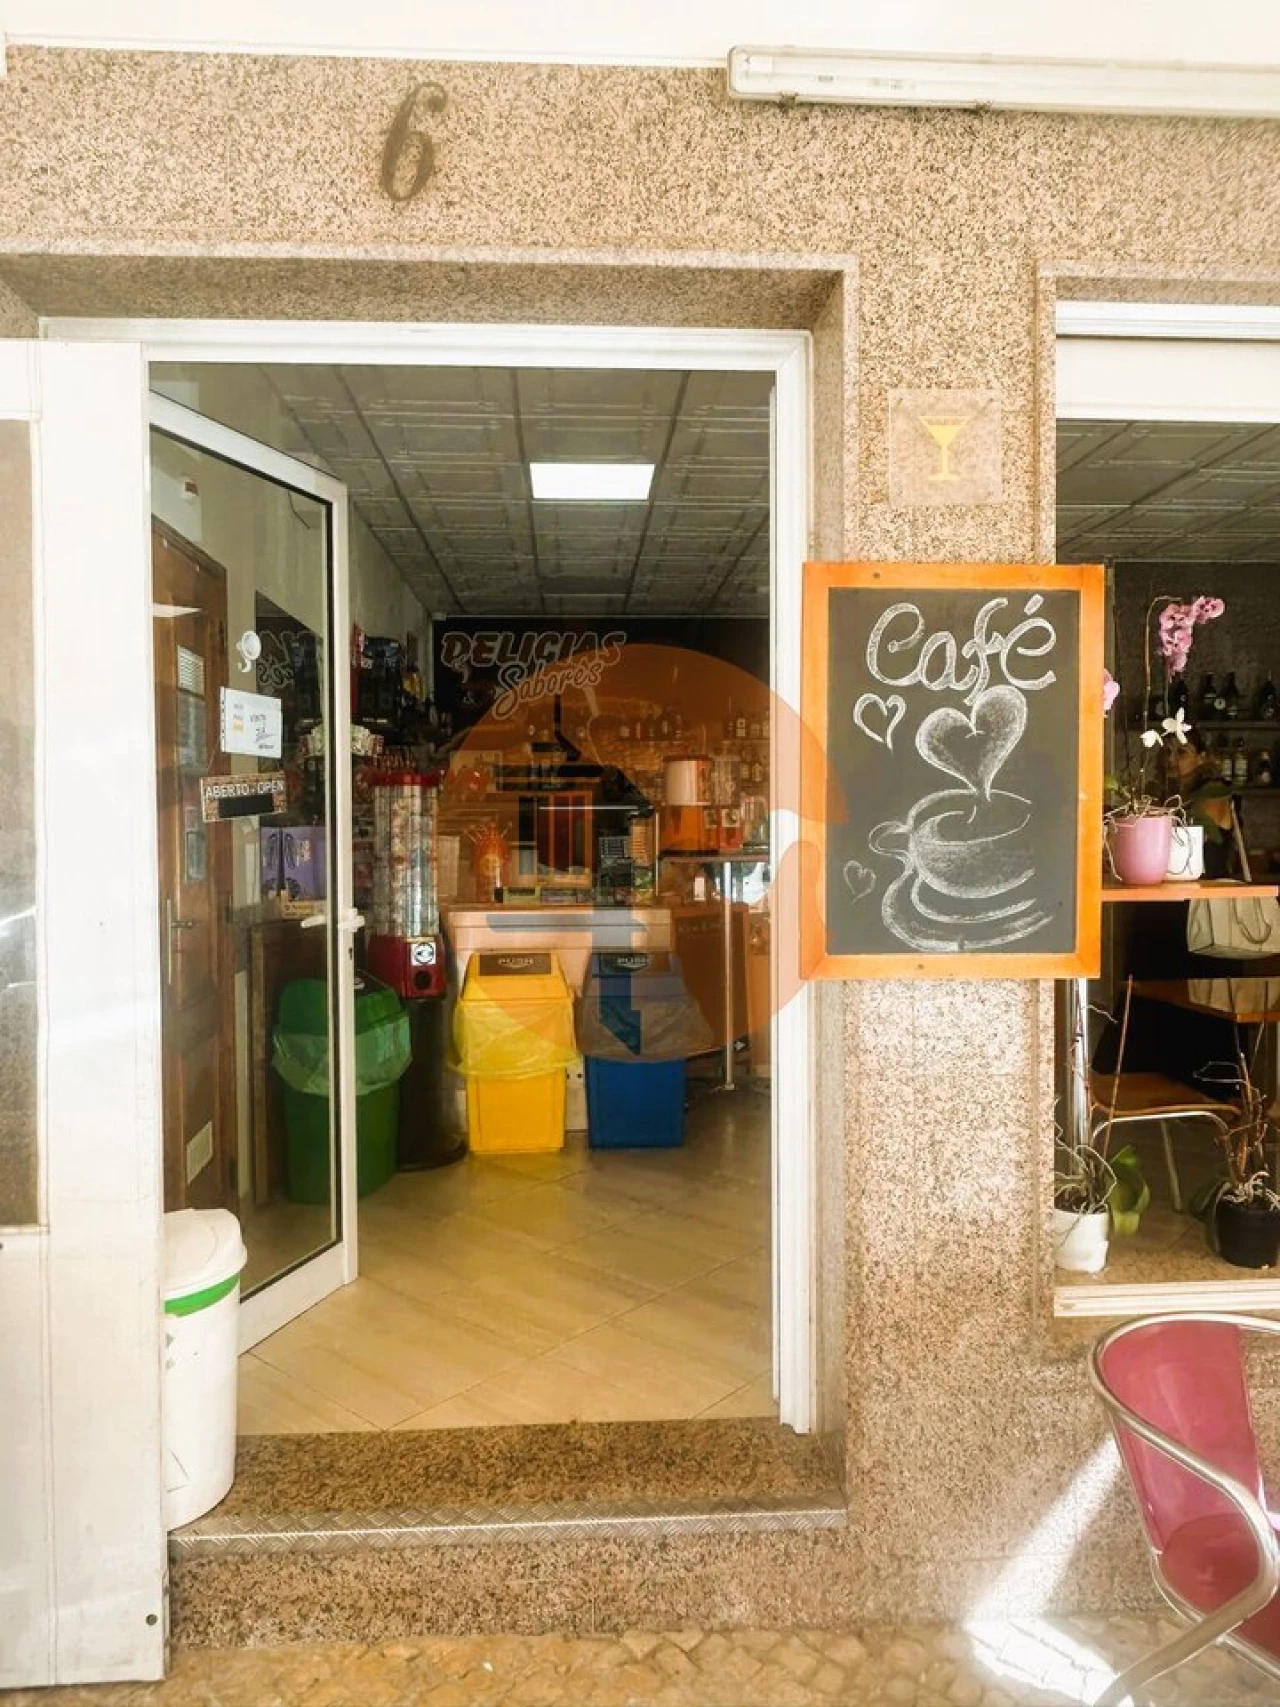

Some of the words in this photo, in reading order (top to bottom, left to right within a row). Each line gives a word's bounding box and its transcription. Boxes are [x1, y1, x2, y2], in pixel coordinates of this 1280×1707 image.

[382, 80, 448, 201] 6
[441, 631, 627, 668] DELICIAS
[866, 593, 1057, 706] Café
[205, 783, 249, 797] ABERTO
[257, 779, 285, 794] OPEN
